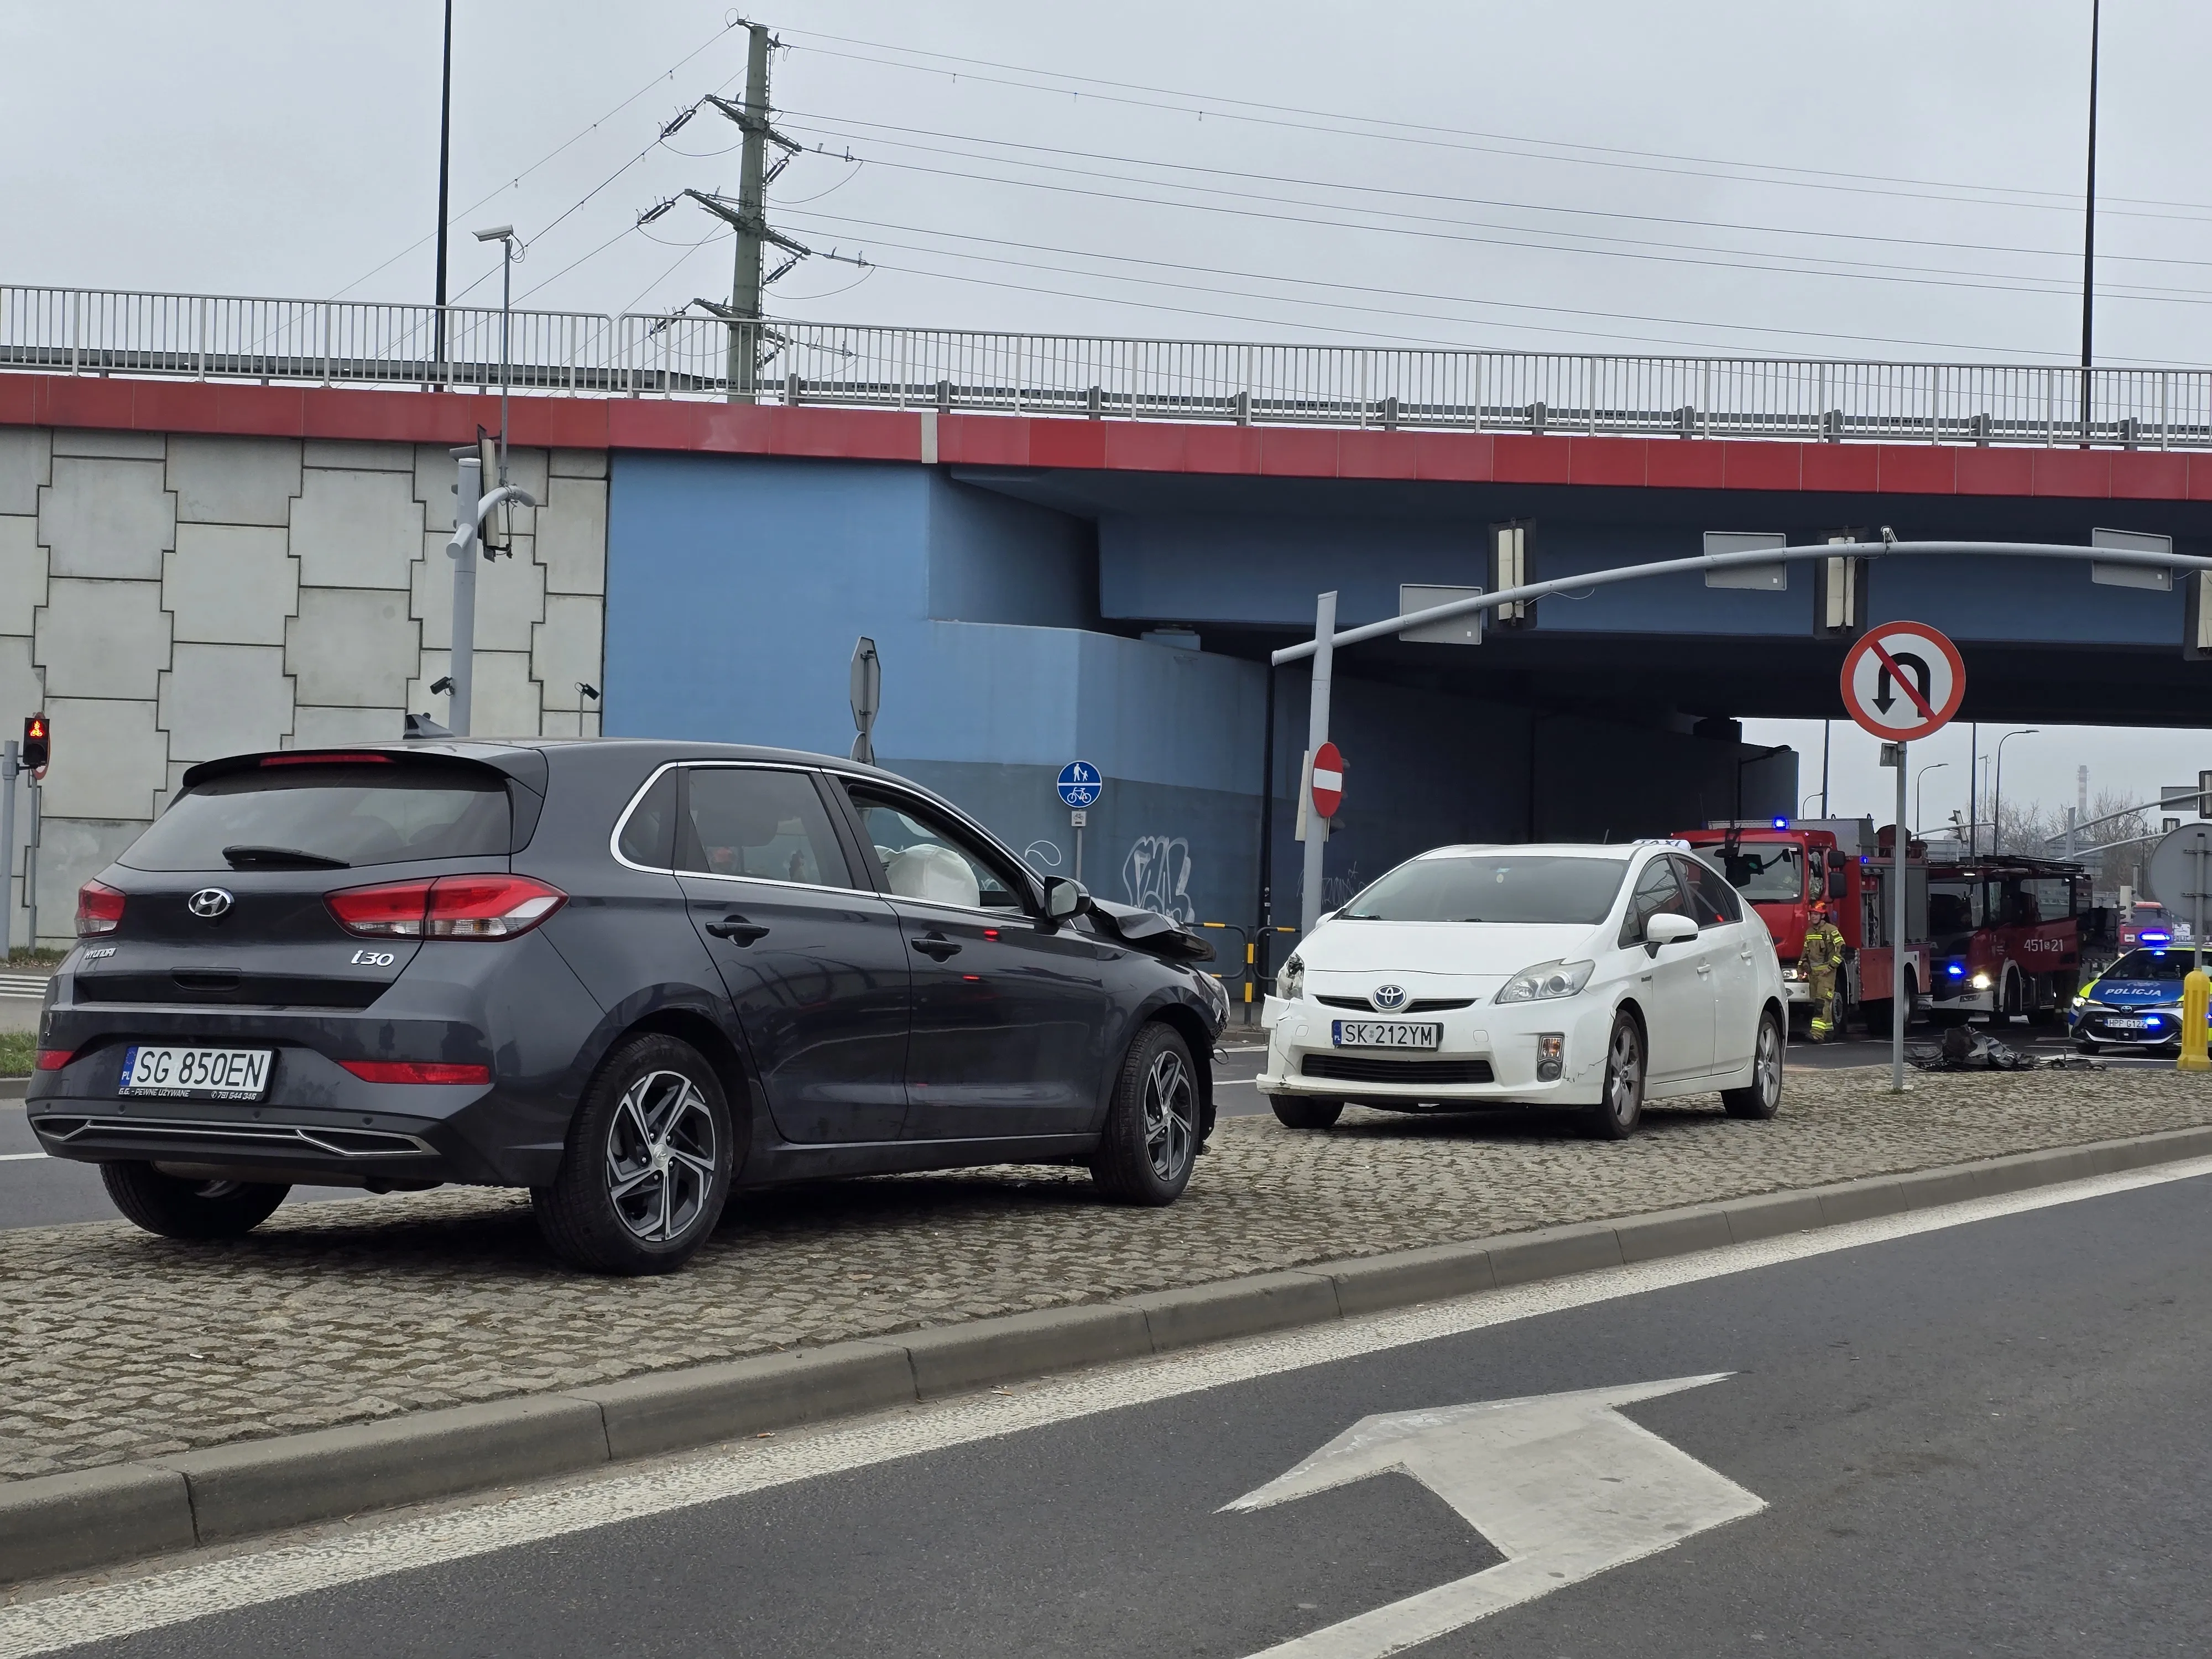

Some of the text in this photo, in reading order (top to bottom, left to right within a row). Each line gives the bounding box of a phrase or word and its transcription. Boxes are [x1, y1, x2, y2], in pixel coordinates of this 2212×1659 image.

[84, 948, 116, 959] HYUNDAI
[351, 950, 394, 966] i30
[2105, 988, 2161, 997] POLICJA
[2109, 1019, 2124, 1027] HPP
[1345, 1024, 1432, 1045] SK 212YM
[137, 1051, 265, 1088] SG 850EN
[121, 1071, 131, 1080] PL
